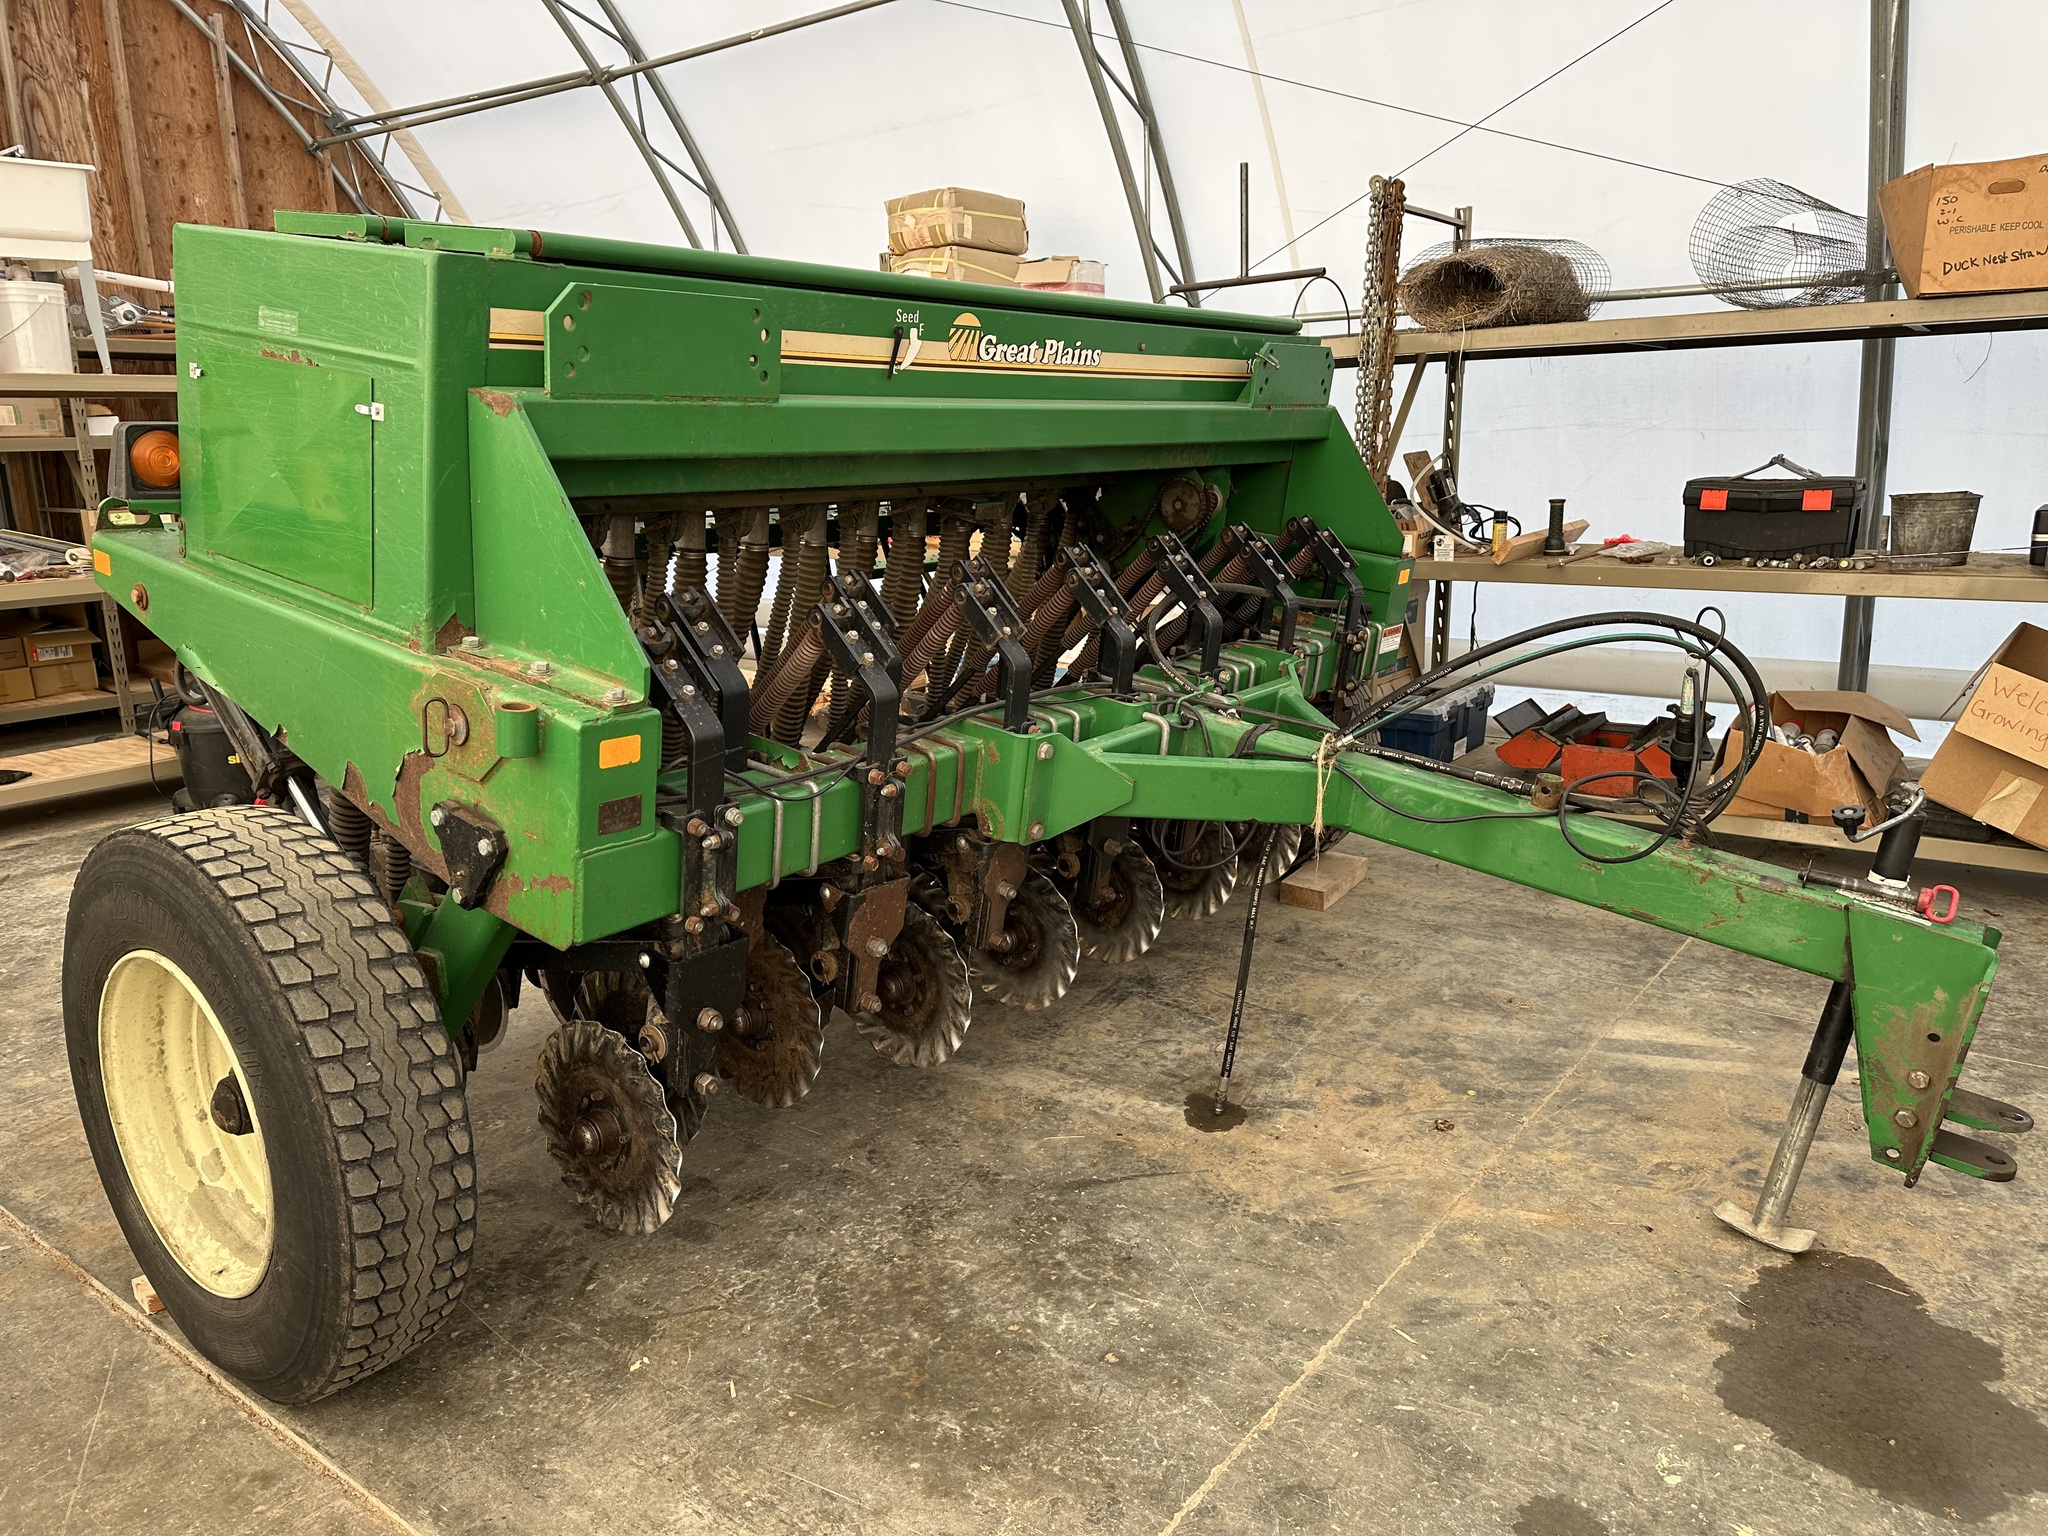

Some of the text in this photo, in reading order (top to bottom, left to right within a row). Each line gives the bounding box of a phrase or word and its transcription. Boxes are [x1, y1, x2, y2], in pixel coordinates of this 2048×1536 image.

[1936, 195, 1958, 206] 150
[1950, 220, 2044, 235] PERISHABLE KEEP COOL
[1943, 257, 1980, 276] DUCK
[1982, 252, 2009, 266] Nest
[896, 308, 920, 324] Seed
[918, 323, 925, 336] F
[977, 334, 1102, 367] Great Plains
[1406, 683, 1421, 694] HOSE
[1993, 676, 2048, 717] Welc
[1970, 699, 2048, 752] Growing
[112, 881, 278, 1111] BRIDGESTONE
